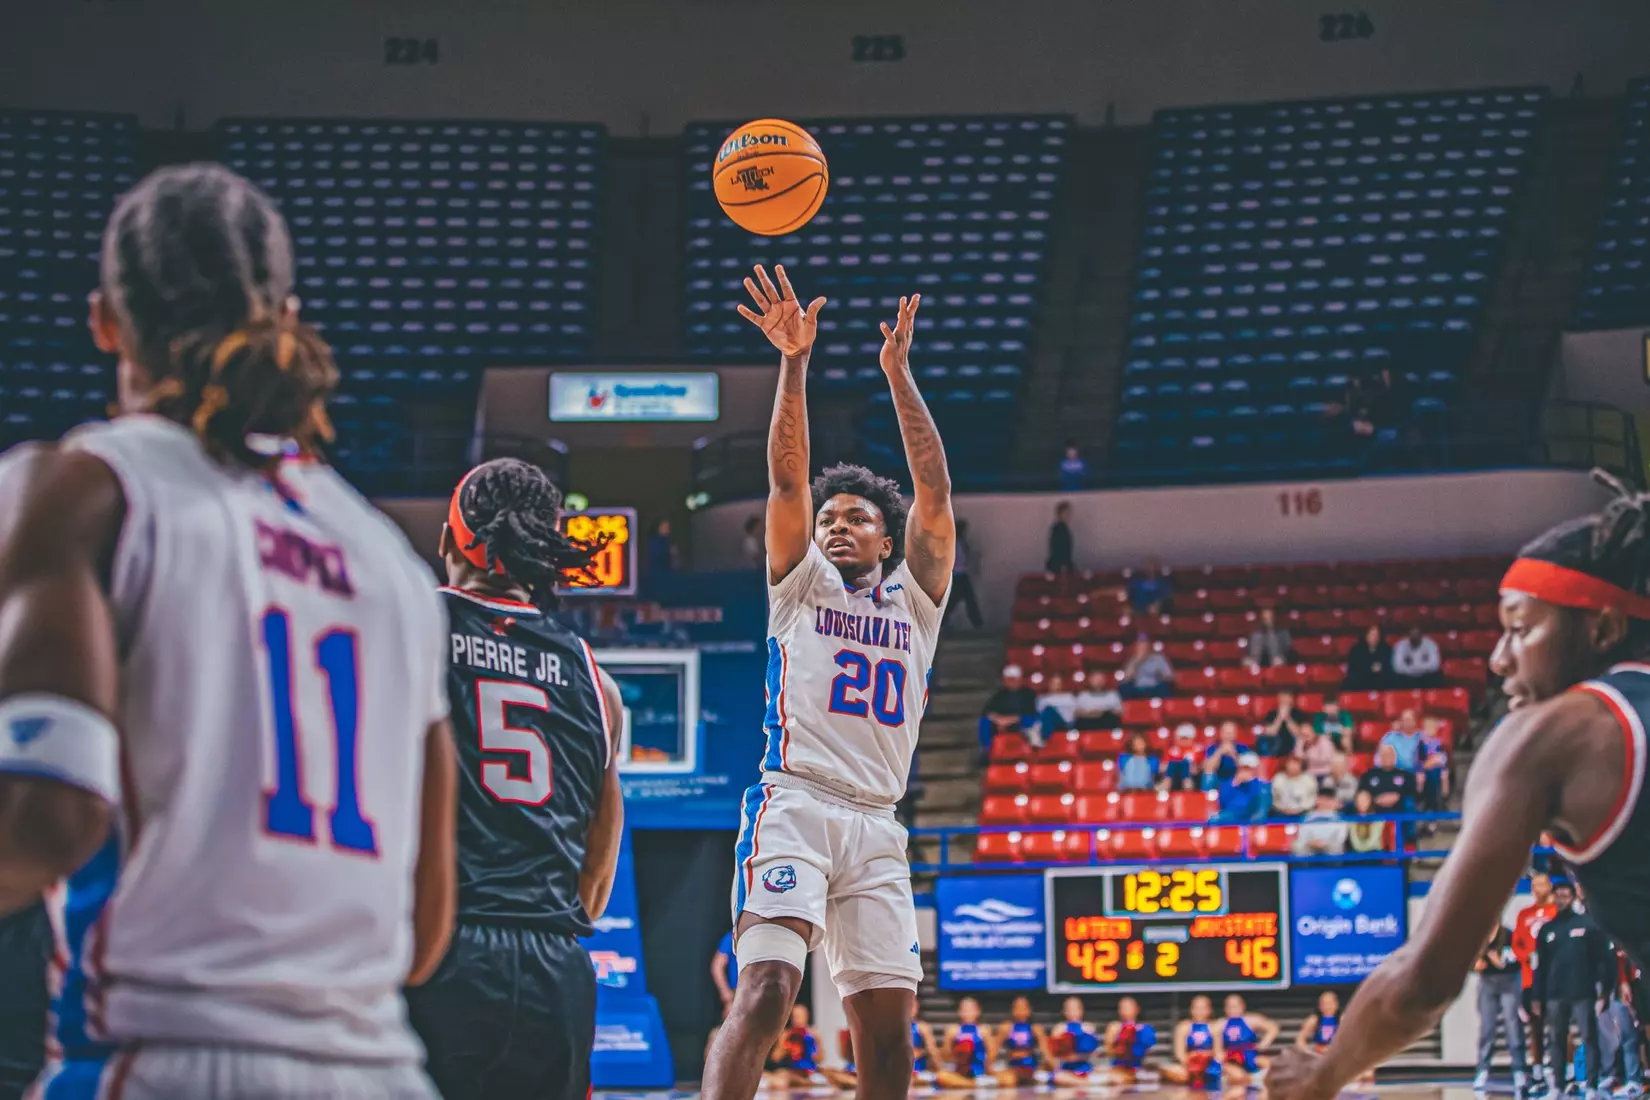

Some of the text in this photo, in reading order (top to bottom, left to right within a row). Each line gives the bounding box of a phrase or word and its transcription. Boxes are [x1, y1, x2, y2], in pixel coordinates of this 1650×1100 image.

[852, 34, 907, 62] 225
[1320, 11, 1374, 42] 226
[384, 36, 439, 65] 224
[718, 133, 788, 162] Wilson
[1276, 488, 1323, 517] 116
[815, 606, 890, 649] LOUISIANA
[451, 633, 569, 687] PIERRE JR.
[828, 648, 907, 728] 20
[259, 602, 382, 859] 11
[475, 678, 553, 807] 5
[1123, 869, 1223, 914] 12:25
[1297, 914, 1398, 939] Origin Bank
[1066, 940, 1120, 982] 42
[1155, 942, 1180, 977] 2
[1224, 936, 1279, 979] 46
